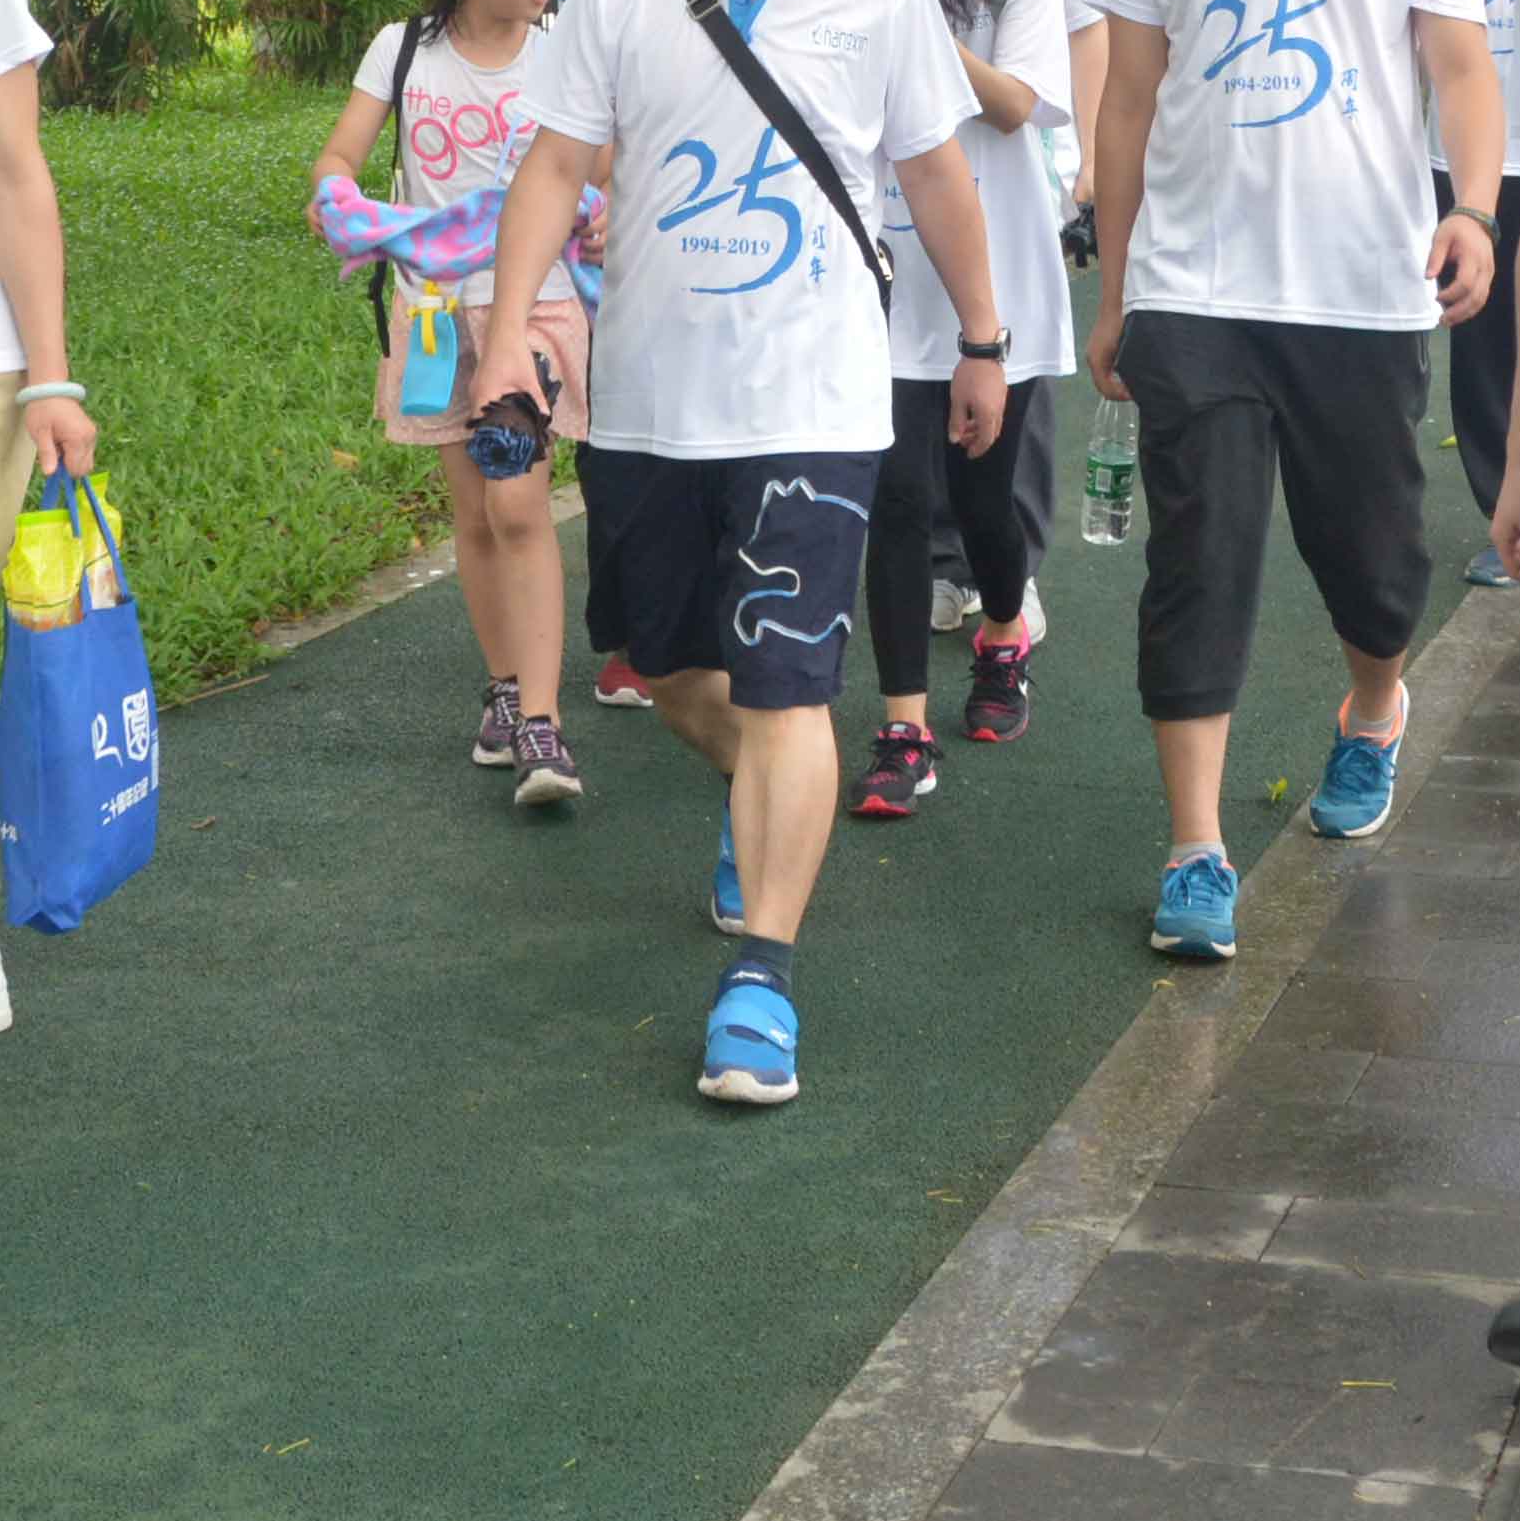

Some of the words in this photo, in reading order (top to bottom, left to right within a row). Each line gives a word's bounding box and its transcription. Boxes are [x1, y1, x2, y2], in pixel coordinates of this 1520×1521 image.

[1224, 75, 1301, 94] 1994-2019
[403, 86, 453, 117] the
[657, 126, 803, 296] 25
[681, 237, 771, 255] 1994-2019
